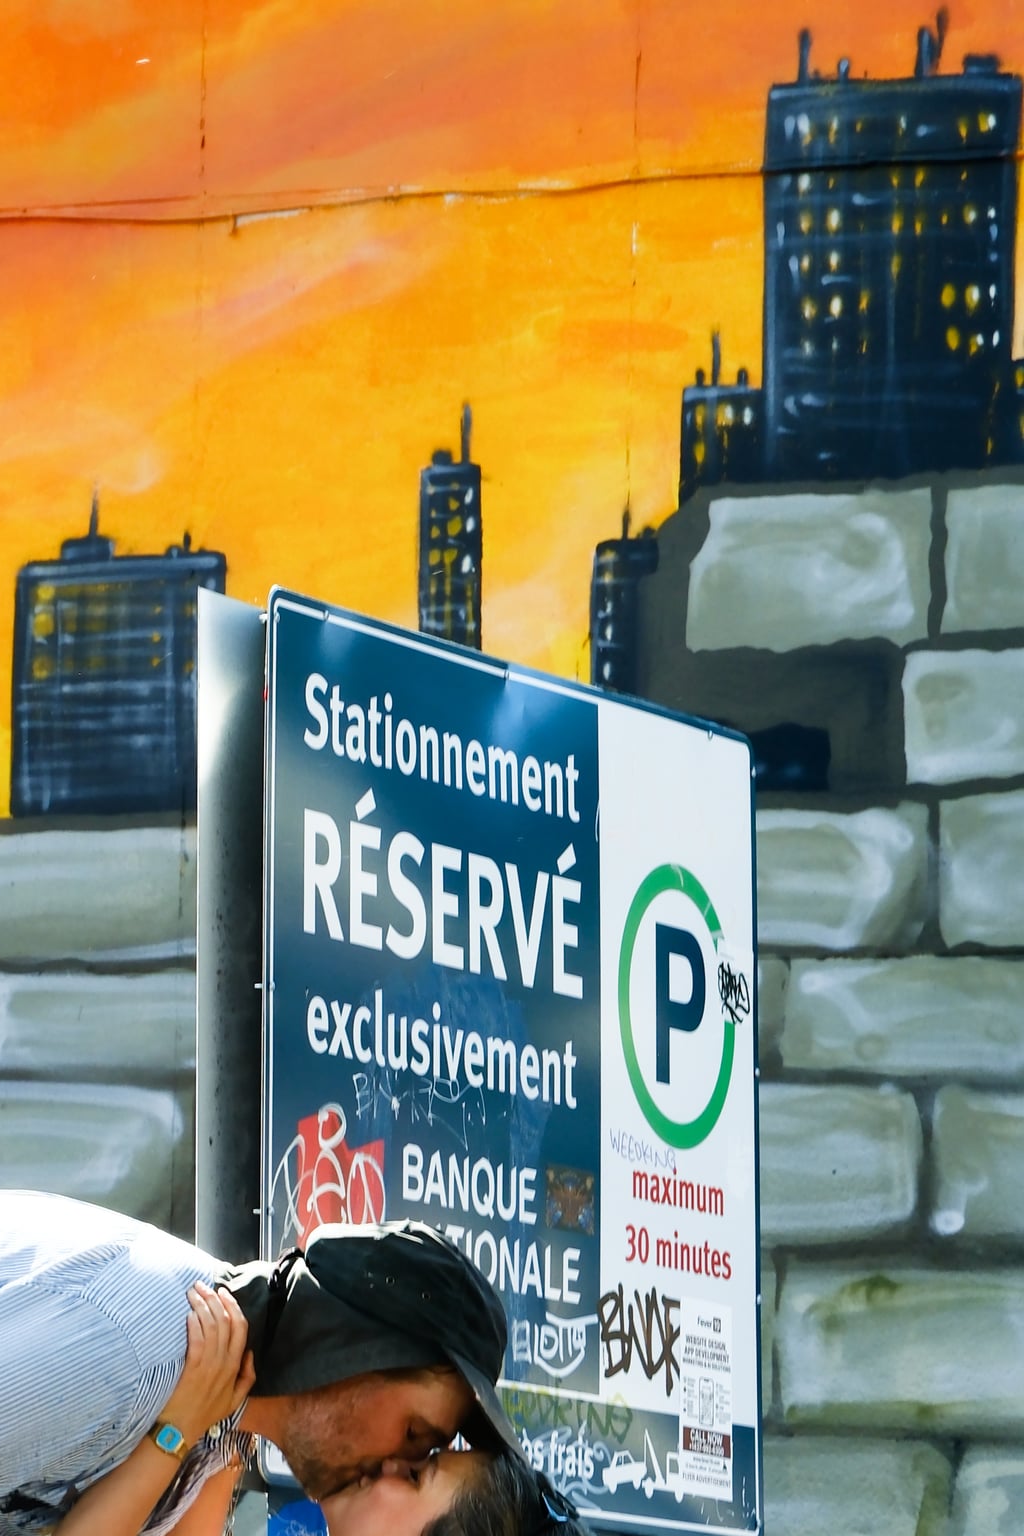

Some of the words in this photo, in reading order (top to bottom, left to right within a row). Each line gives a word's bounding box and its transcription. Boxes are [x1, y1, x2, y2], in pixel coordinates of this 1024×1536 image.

[303, 672, 581, 823] Stationnement
[302, 787, 584, 1000] RÉSERVÉ
[655, 921, 706, 1085] P
[307, 989, 577, 1109] exclusivement
[402, 1143, 537, 1225] BANQUE
[633, 1167, 724, 1216] maximum
[437, 1222, 581, 1304] TIONALE
[625, 1224, 650, 1264] 30
[656, 1230, 732, 1280] minutes
[684, 1346, 695, 1356] APP
[695, 1348, 730, 1363] DEVELOPMENT
[685, 1335, 707, 1348] WEBSITE
[548, 1429, 594, 1481] frais
